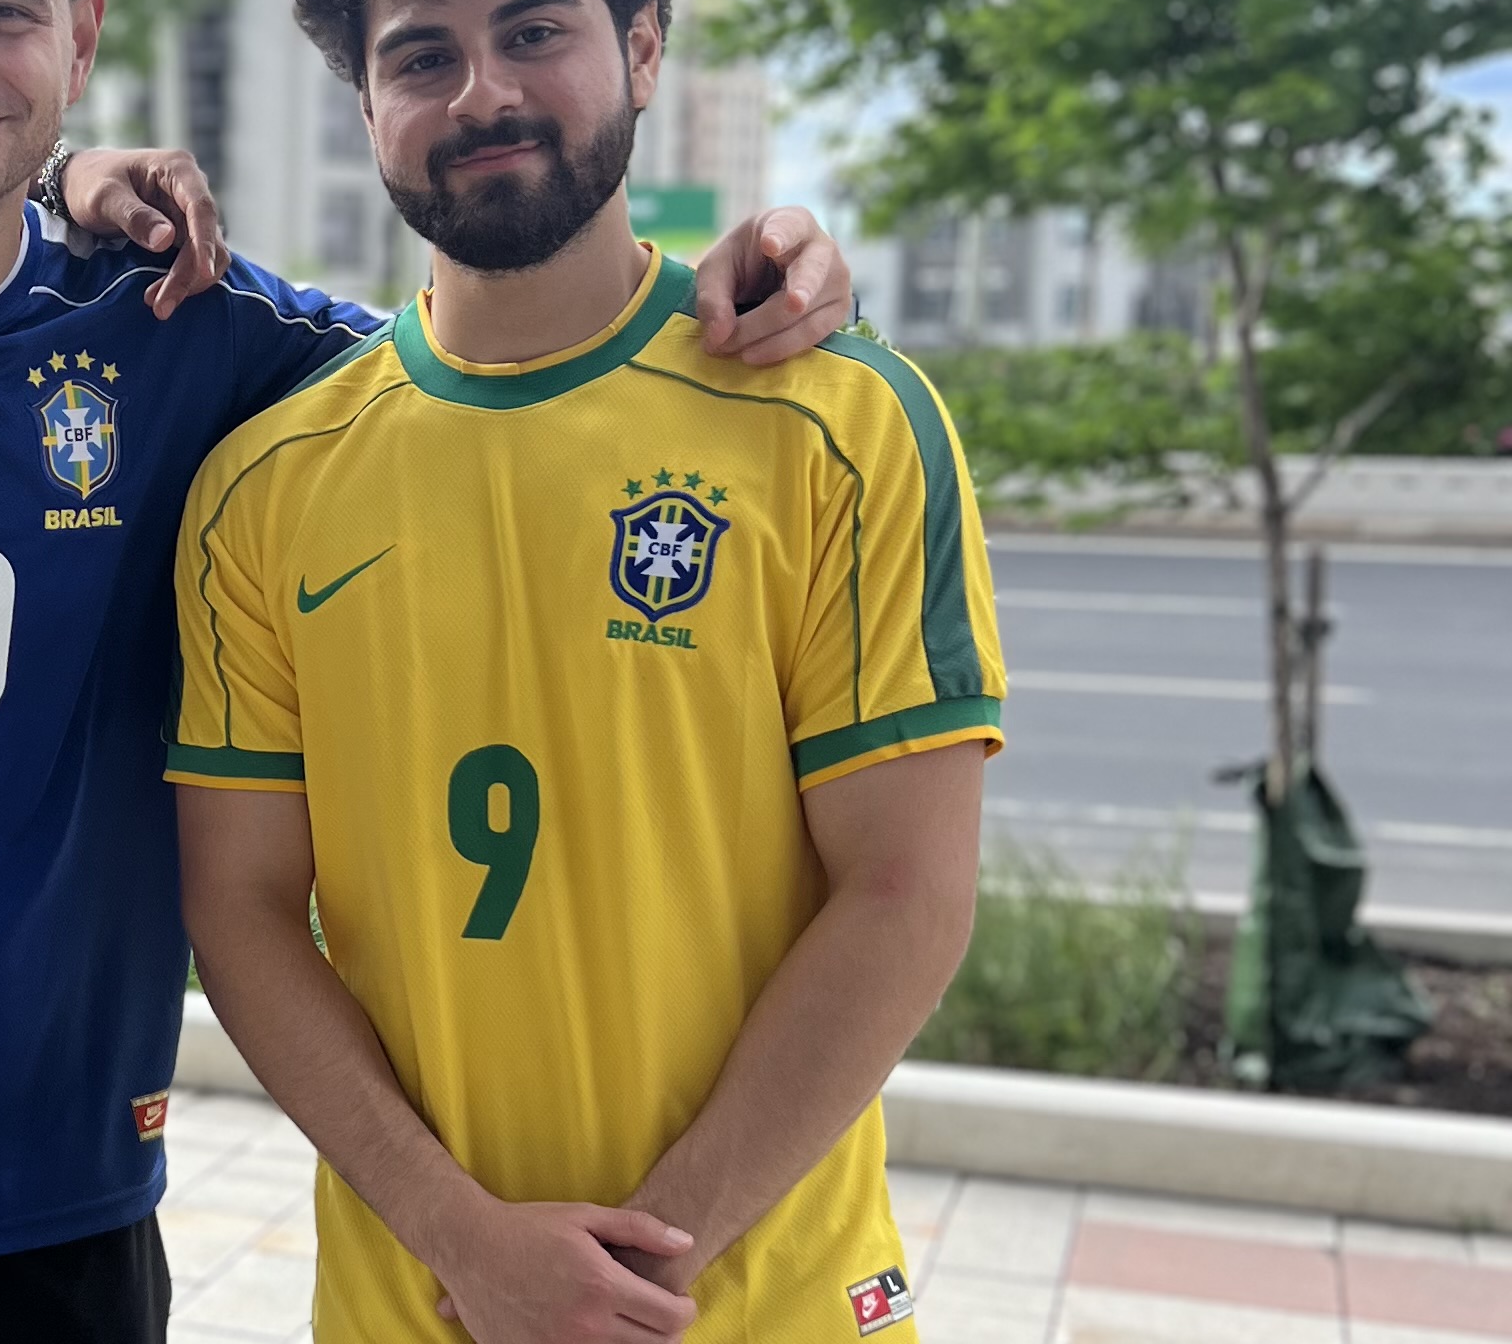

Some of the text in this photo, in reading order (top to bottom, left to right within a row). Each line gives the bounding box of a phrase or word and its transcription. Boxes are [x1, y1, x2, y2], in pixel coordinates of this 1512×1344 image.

[64, 427, 93, 442] CBF
[44, 506, 123, 530] BRASIL
[648, 542, 683, 558] CBF
[605, 618, 698, 650] BRASIL
[447, 743, 541, 941] 9
[886, 1275, 901, 1293] L
